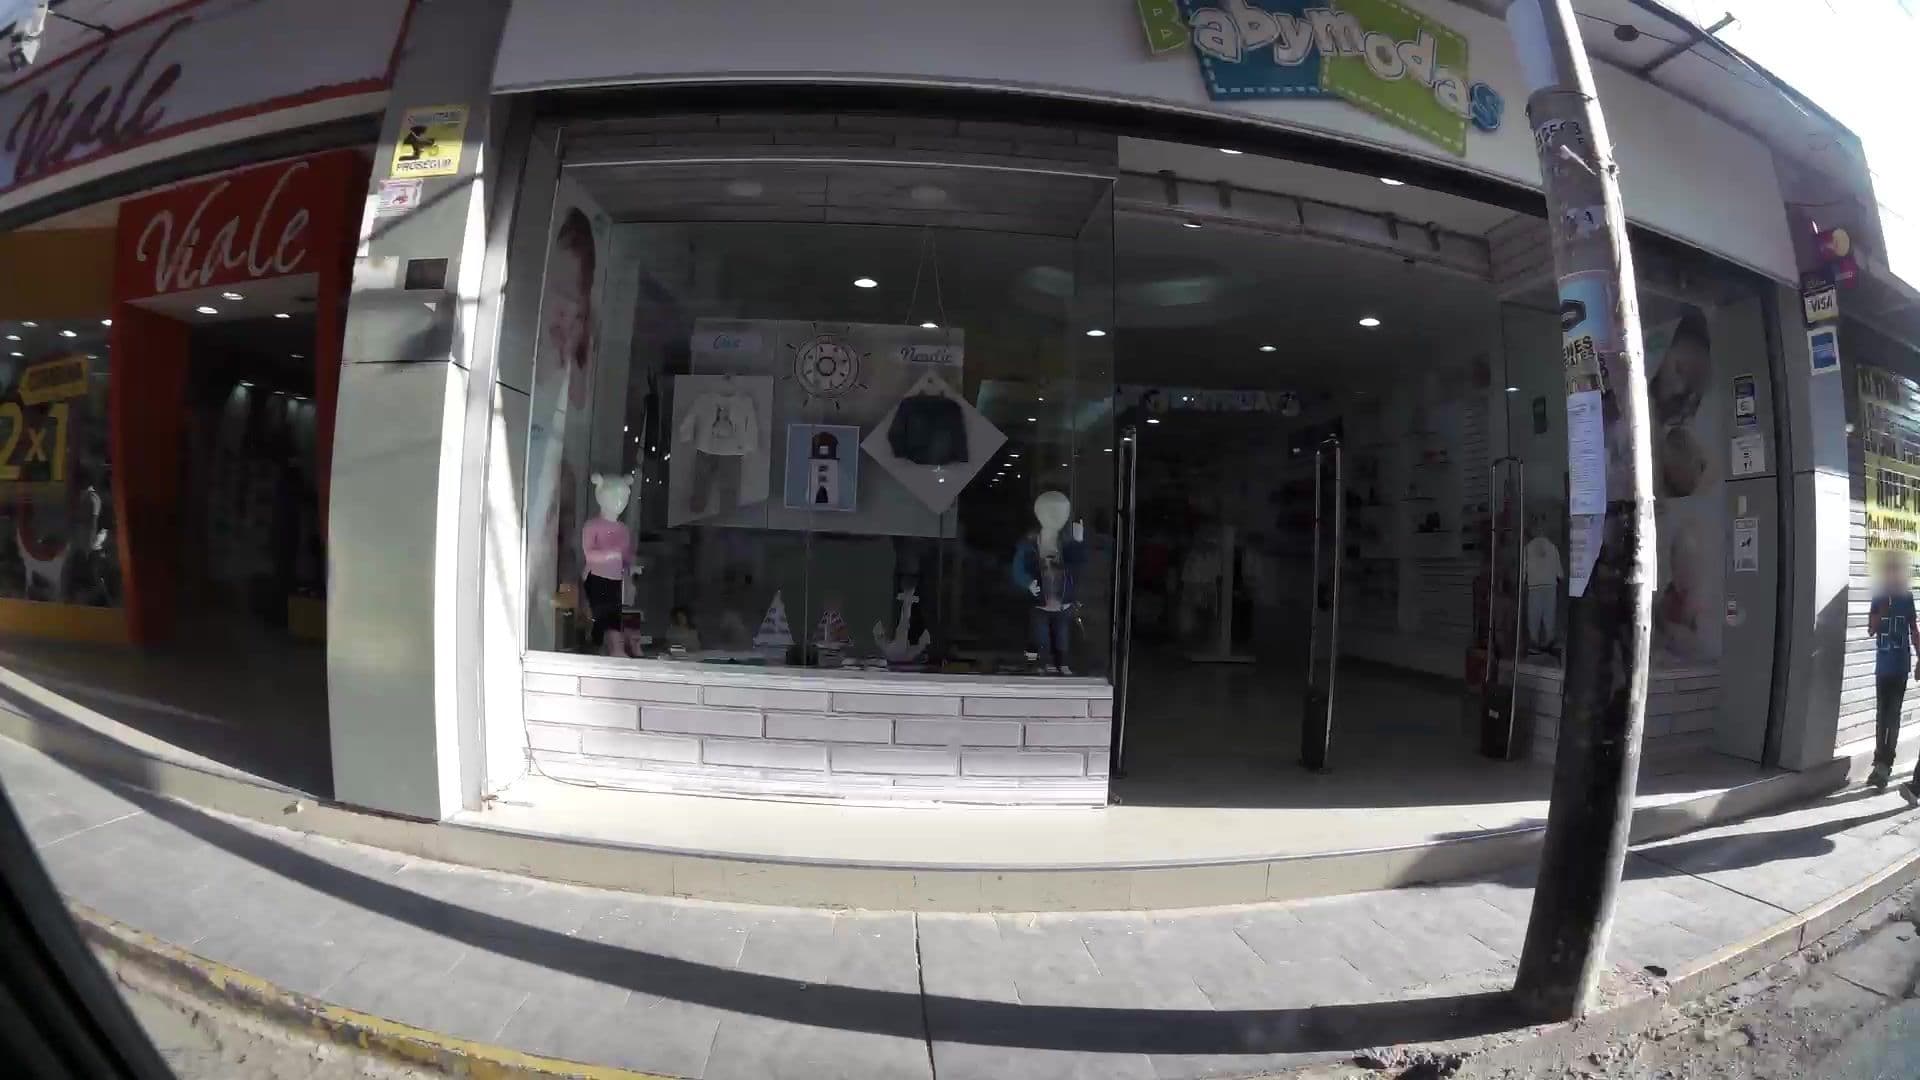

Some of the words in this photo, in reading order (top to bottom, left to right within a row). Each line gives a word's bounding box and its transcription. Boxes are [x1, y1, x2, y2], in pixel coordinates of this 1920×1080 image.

[4, 16, 193, 184] Viale
[136, 161, 310, 293] Viale
[1810, 294, 1833, 313] VISA
[0, 401, 69, 481] 2x1
